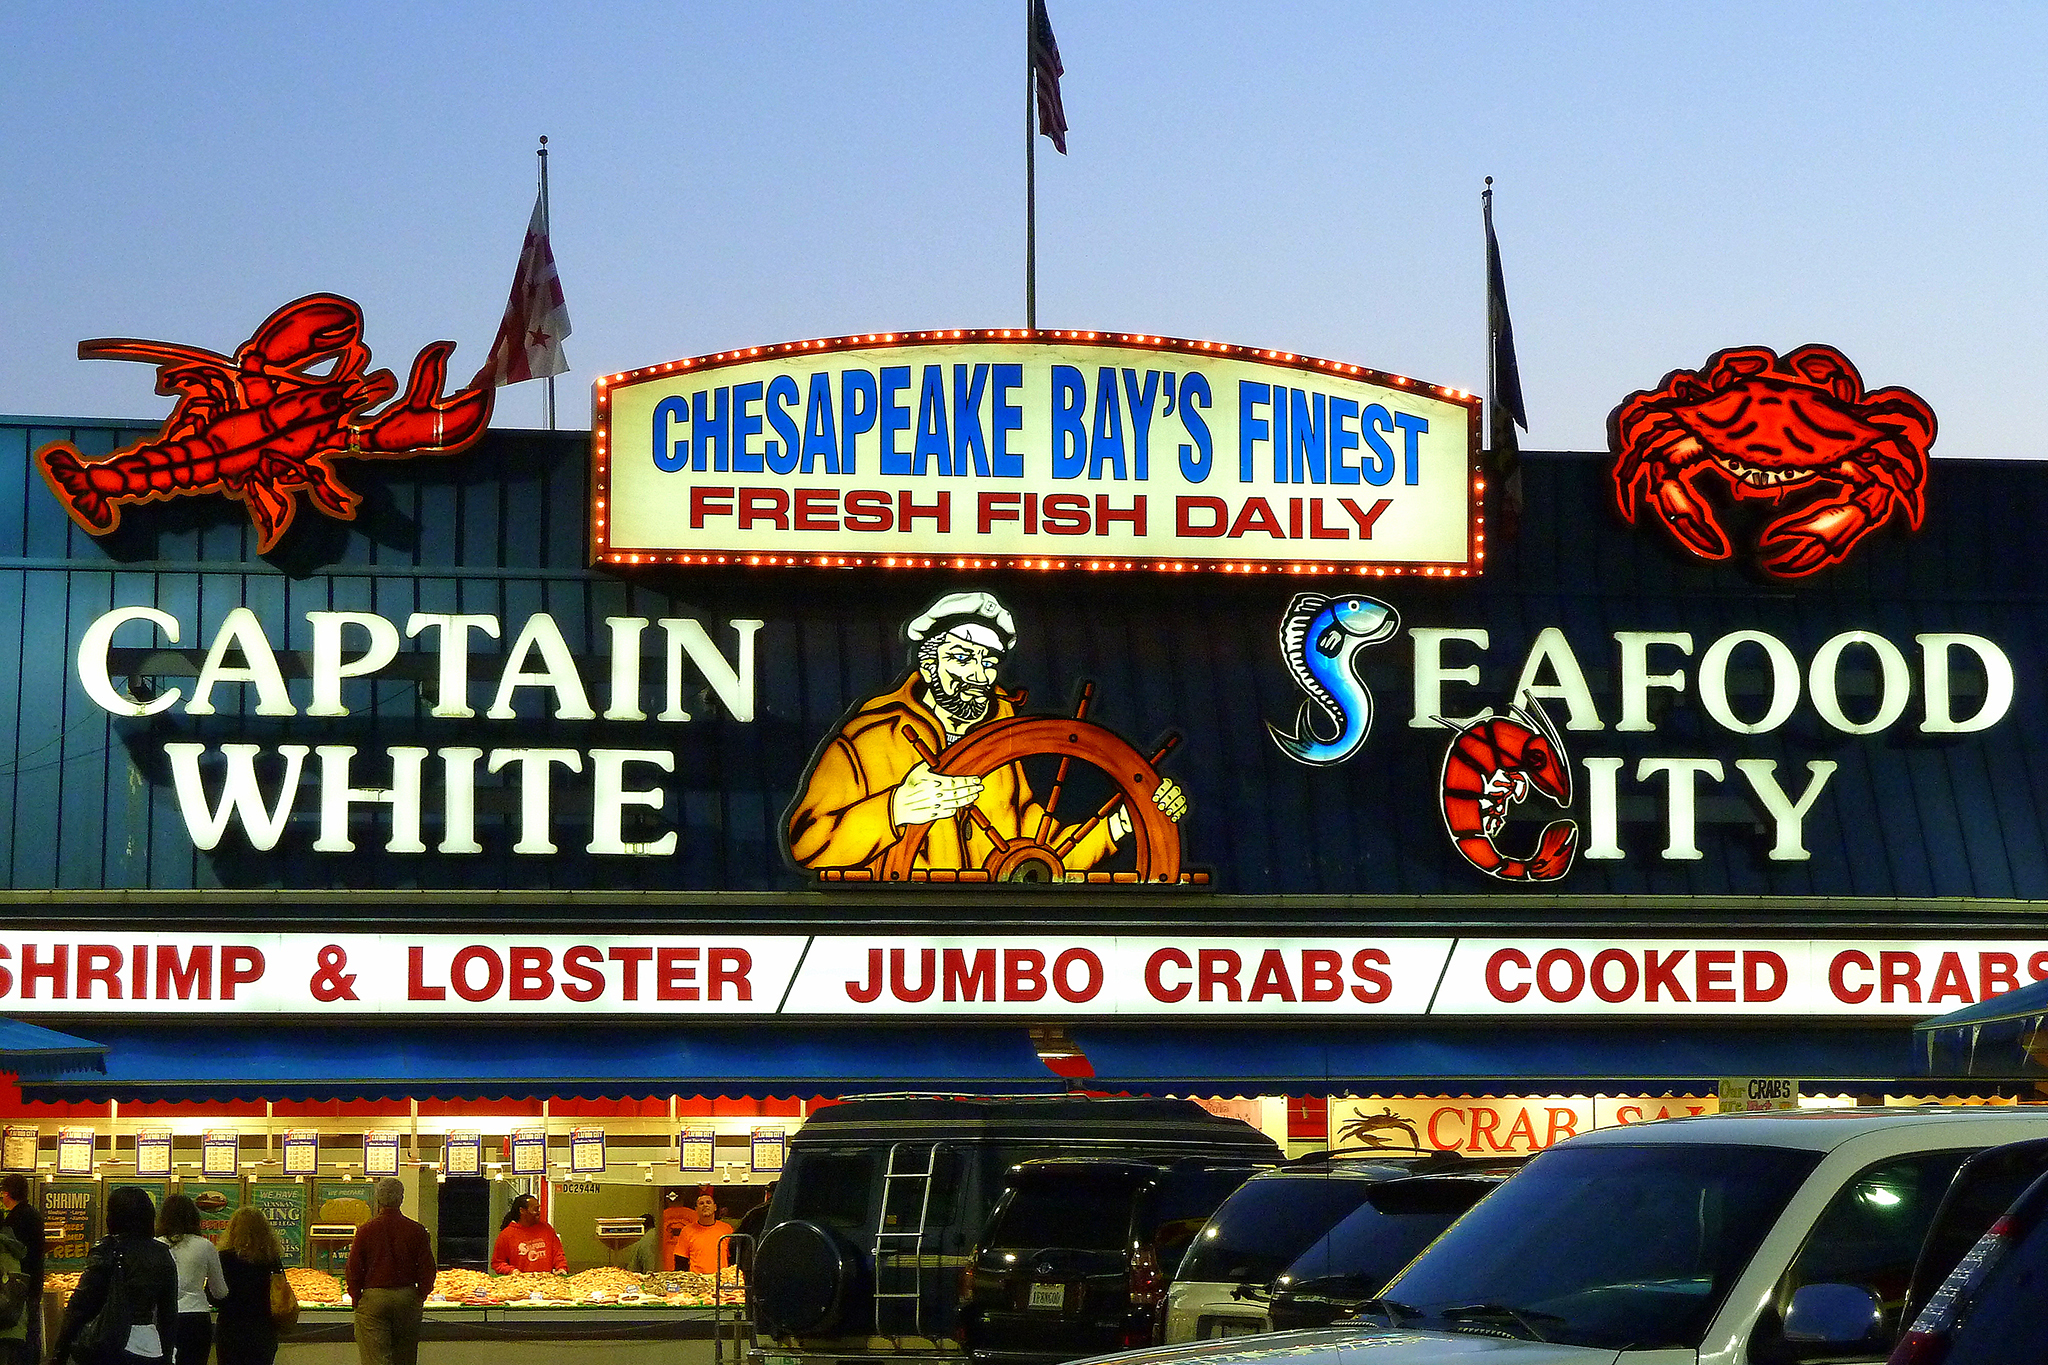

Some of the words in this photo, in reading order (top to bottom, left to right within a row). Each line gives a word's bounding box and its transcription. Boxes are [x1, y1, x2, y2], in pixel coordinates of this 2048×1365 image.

[651, 362, 1024, 478] CHESAPEAKE
[1051, 364, 1213, 483] BAY'S
[1238, 380, 1429, 487] FINEST
[689, 486, 951, 533] FRESH
[977, 492, 1148, 537] FISH
[1175, 496, 1394, 540] DAILY
[77, 606, 765, 723] CAPTAIN
[163, 742, 678, 856] WHITE
[310, 944, 361, 1002] &
[408, 945, 753, 1003] LOBSTER
[845, 947, 1104, 1003] JUMBO
[1144, 947, 1394, 1004] CRABS
[1485, 948, 1789, 1003] COOKED
[1748, 1080, 1791, 1099] CRABS
[1427, 1105, 1577, 1152] CRAB
[45, 1192, 91, 1209] SHRIMP
